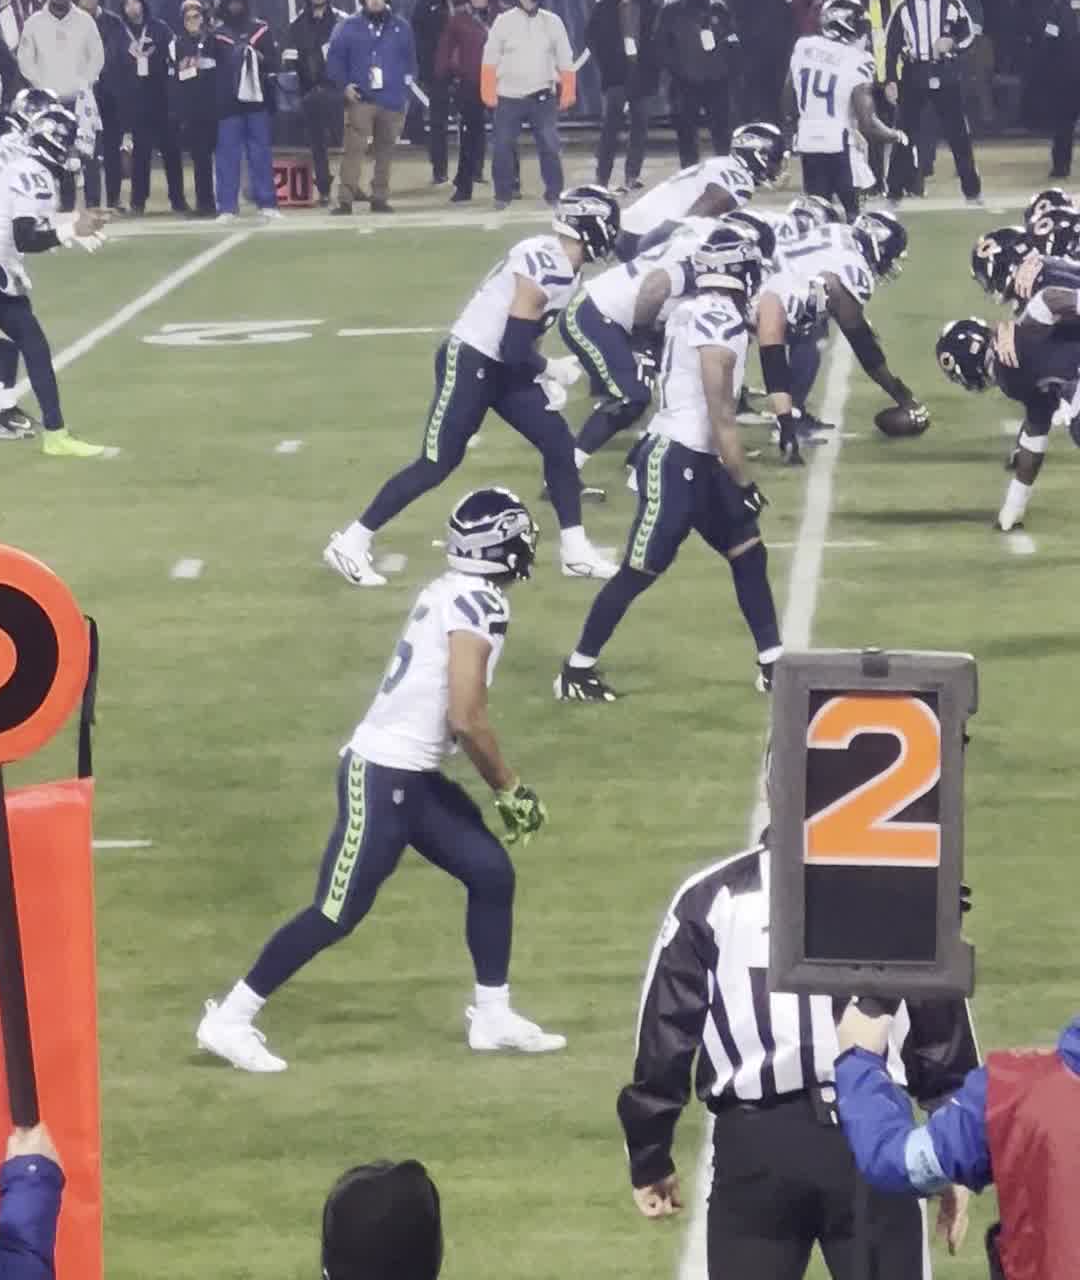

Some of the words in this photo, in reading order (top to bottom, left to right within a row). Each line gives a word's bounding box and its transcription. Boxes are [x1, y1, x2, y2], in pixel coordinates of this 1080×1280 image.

[798, 66, 839, 118] 14
[273, 166, 311, 202] 20
[803, 693, 942, 867] 2
